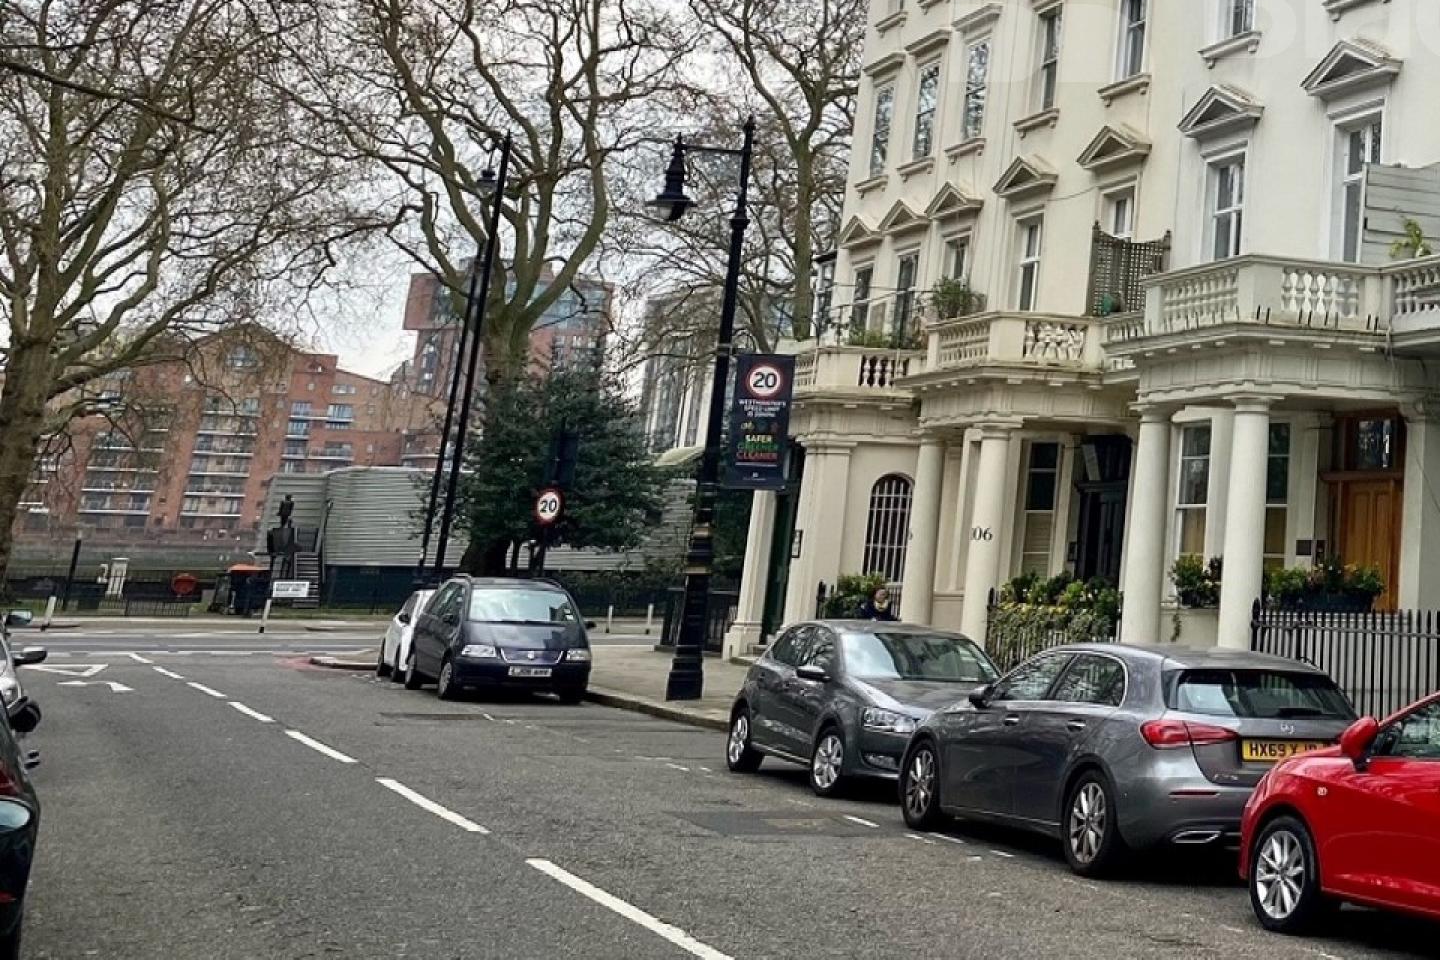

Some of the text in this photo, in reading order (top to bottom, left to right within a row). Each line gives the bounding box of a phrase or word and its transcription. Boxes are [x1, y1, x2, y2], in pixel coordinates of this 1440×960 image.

[752, 371, 778, 388] 20
[540, 499, 557, 513] 20
[1249, 742, 1286, 758] HX69
